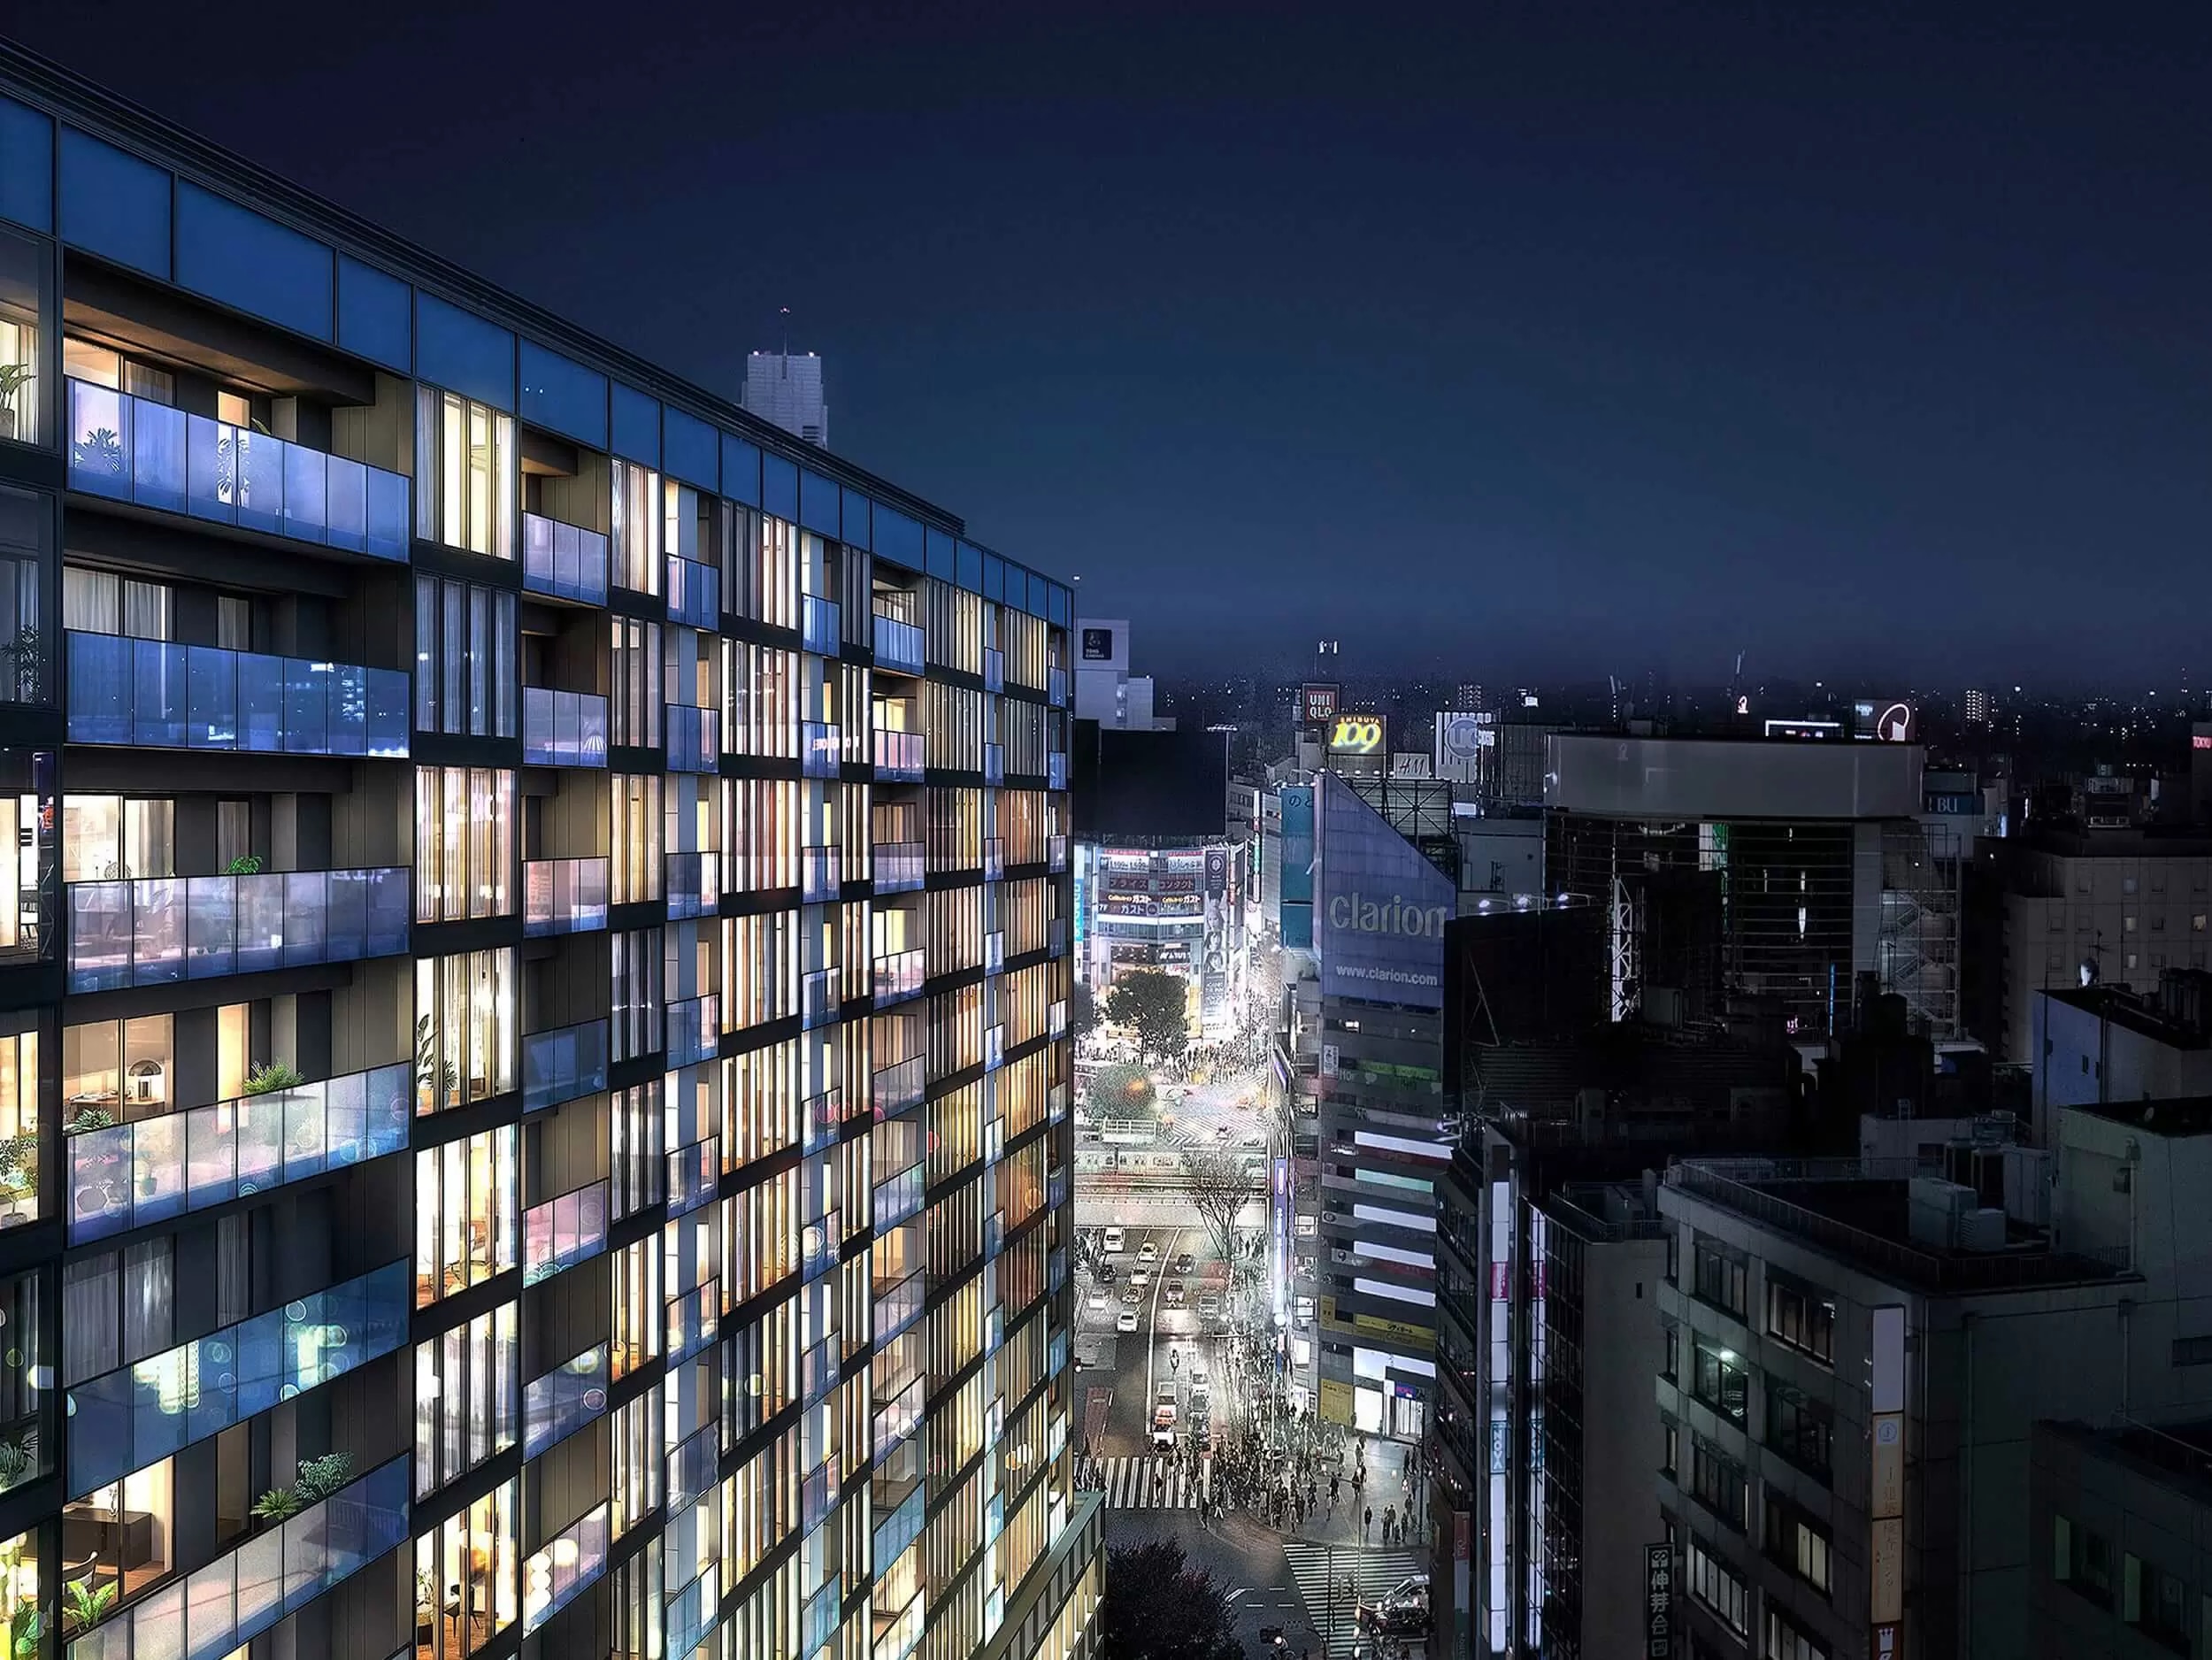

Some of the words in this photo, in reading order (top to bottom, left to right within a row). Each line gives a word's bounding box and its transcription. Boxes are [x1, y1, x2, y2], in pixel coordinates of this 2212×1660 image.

[1310, 694, 1331, 706] UNI
[1310, 706, 1333, 719] QLO
[1340, 716, 1381, 725] SHIBUYA
[1331, 722, 1381, 752] 109
[1330, 893, 1447, 938] Clarion
[1336, 963, 1439, 987] www.clarion.com
